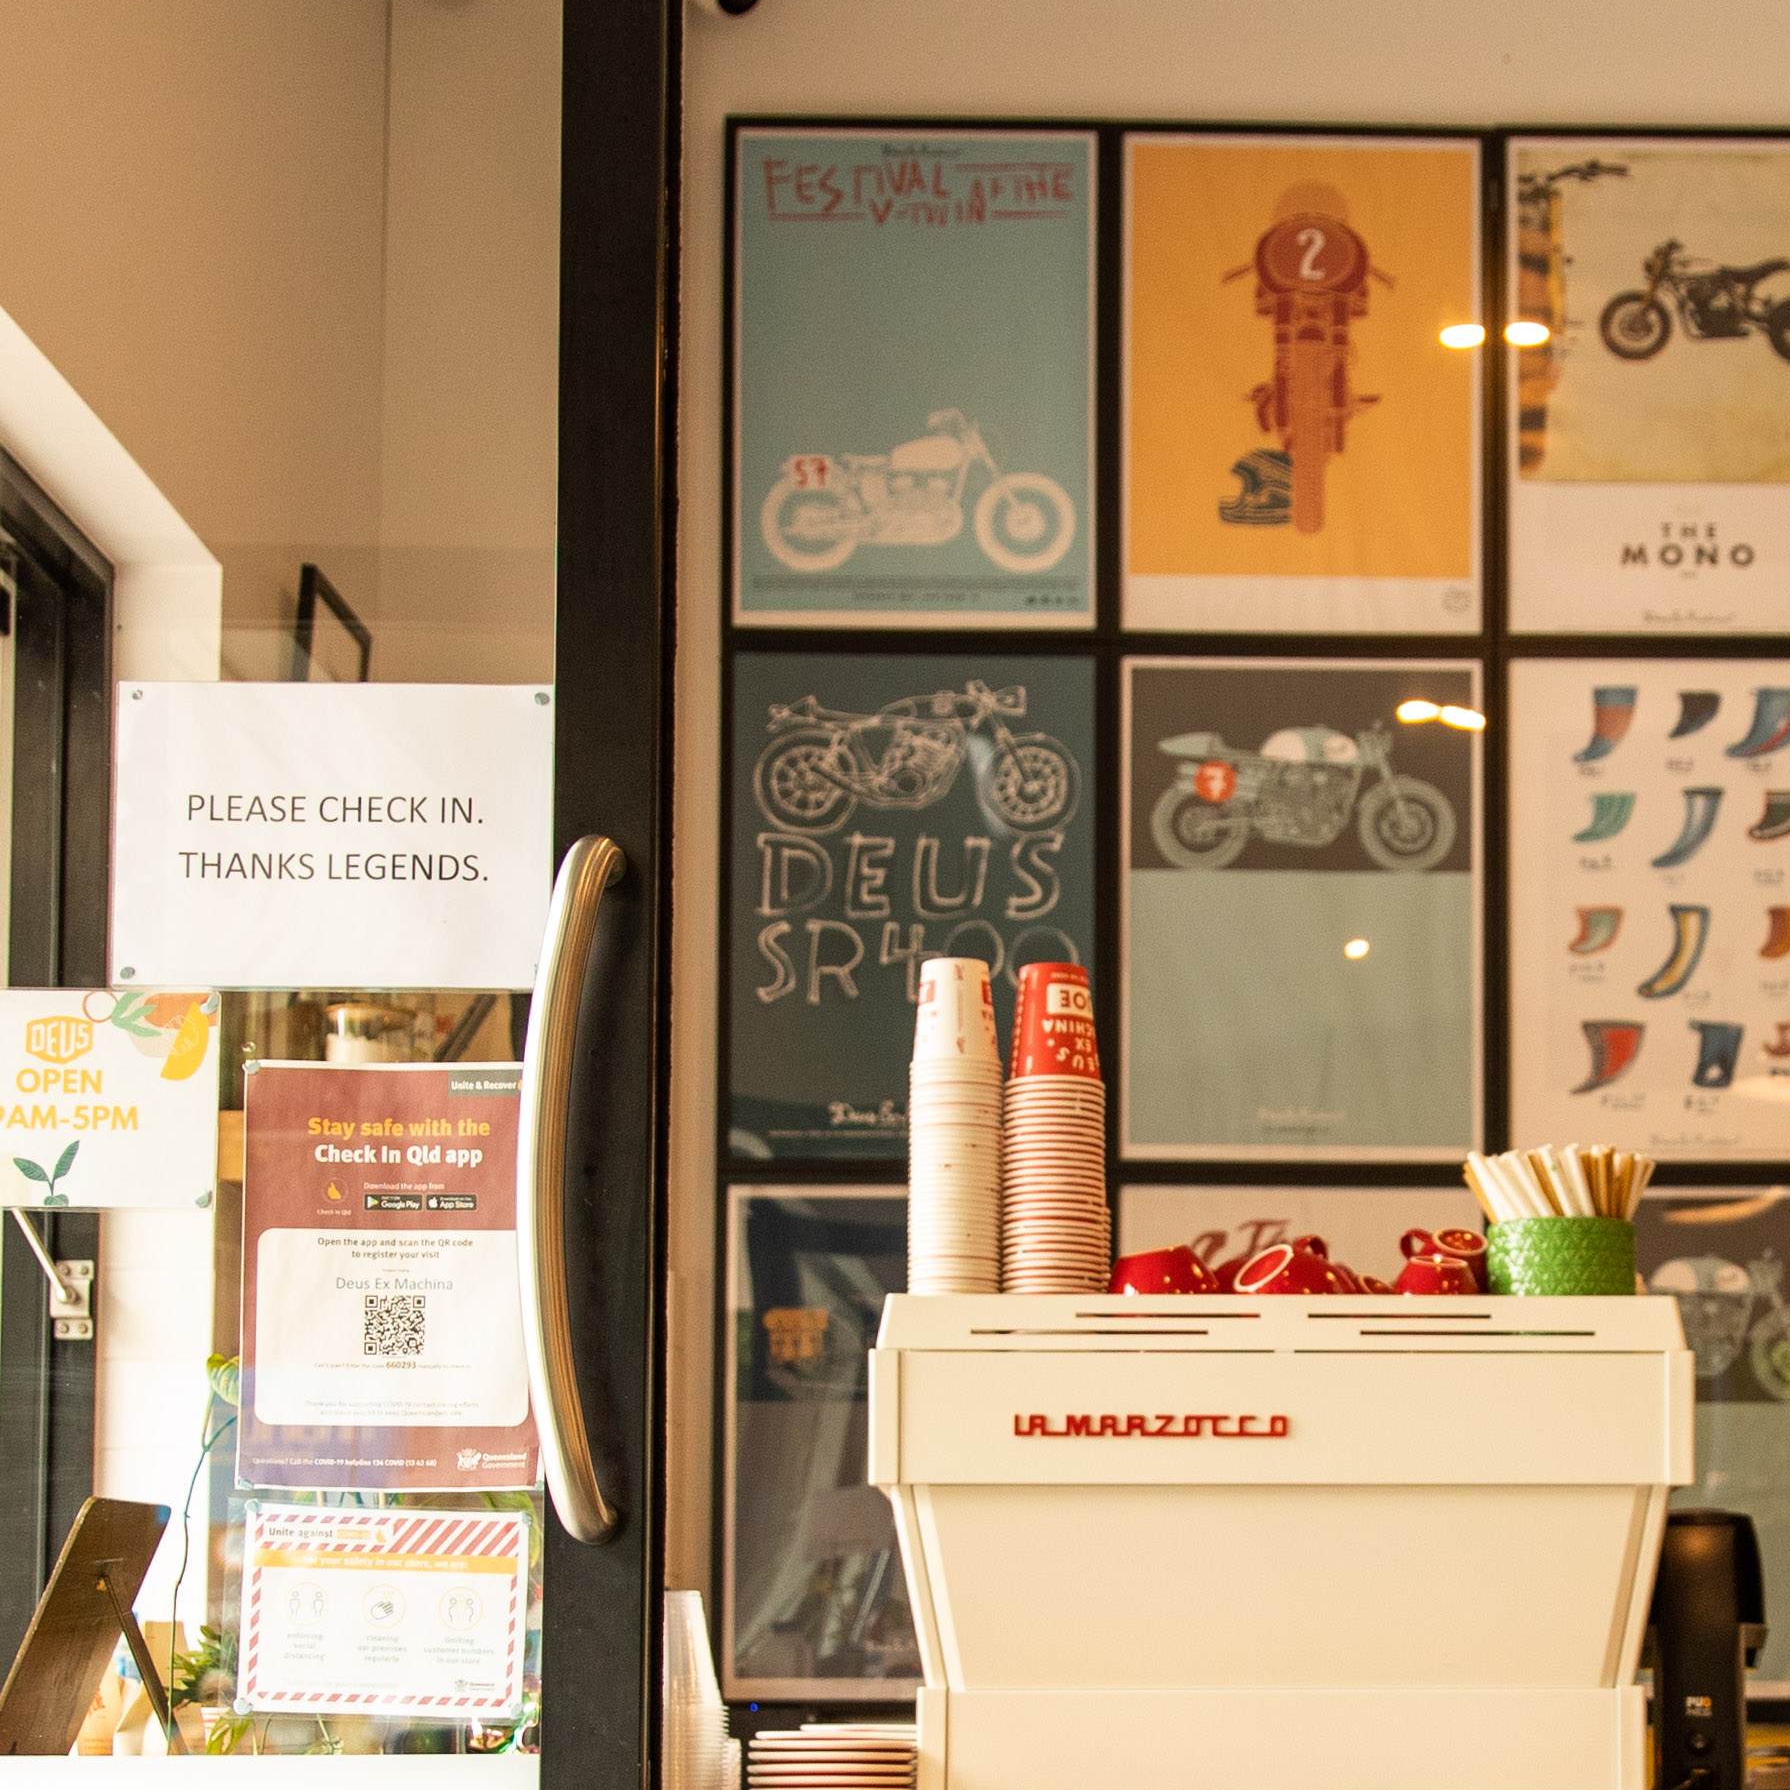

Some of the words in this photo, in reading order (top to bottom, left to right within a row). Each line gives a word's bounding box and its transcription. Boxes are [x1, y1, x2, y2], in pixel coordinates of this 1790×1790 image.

[763, 157, 951, 215] FESTIVAL
[1296, 229, 1326, 281] 2
[1661, 520, 1718, 539] THE
[1620, 542, 1756, 567] MONO
[186, 794, 308, 824] PLEASE
[318, 795, 429, 824] CHECK
[439, 796, 485, 825] IN.
[178, 851, 315, 881] THANKS
[327, 852, 490, 882] LEGENDS.
[755, 830, 1066, 922] DEUS
[30, 1020, 90, 1059] DEUS
[16, 1068, 103, 1095] OPEN
[451, 1080, 475, 1091] Unite
[475, 1081, 483, 1090] &
[483, 1080, 517, 1091] Recover
[0, 1104, 139, 1131] AM-5PM
[307, 1117, 356, 1141] Stay
[360, 1118, 404, 1137] safe
[408, 1118, 452, 1137] with
[457, 1118, 491, 1137] the
[314, 1144, 377, 1164] Check
[381, 1146, 402, 1164] In
[406, 1145, 442, 1167] Qld
[445, 1148, 484, 1168] app
[363, 1182, 400, 1191] Download
[400, 1182, 413, 1191] the
[428, 1183, 445, 1191] from
[380, 1199, 406, 1210] Google
[405, 1199, 421, 1210] Play
[439, 1200, 455, 1210] App
[317, 1237, 342, 1248] Open
[343, 1238, 359, 1247] the
[360, 1239, 378, 1248] app
[379, 1238, 396, 1247] and
[398, 1239, 419, 1247] scan
[421, 1238, 436, 1247] the
[437, 1238, 451, 1248] QR
[452, 1238, 474, 1247] code
[351, 1250, 361, 1259] to
[363, 1250, 398, 1260] register
[399, 1252, 419, 1260] your
[421, 1250, 440, 1259] visit
[335, 1277, 371, 1290] Deus
[374, 1277, 391, 1290] Ex
[394, 1277, 454, 1291] Machina
[386, 1361, 417, 1369] 660293
[385, 1459, 405, 1467] COVID
[482, 1452, 527, 1460] Queensland
[482, 1461, 526, 1469] Government
[268, 1527, 295, 1537] Unite
[298, 1529, 333, 1539] against
[319, 1557, 342, 1566] your
[343, 1557, 374, 1568] safety
[386, 1559, 404, 1567] our
